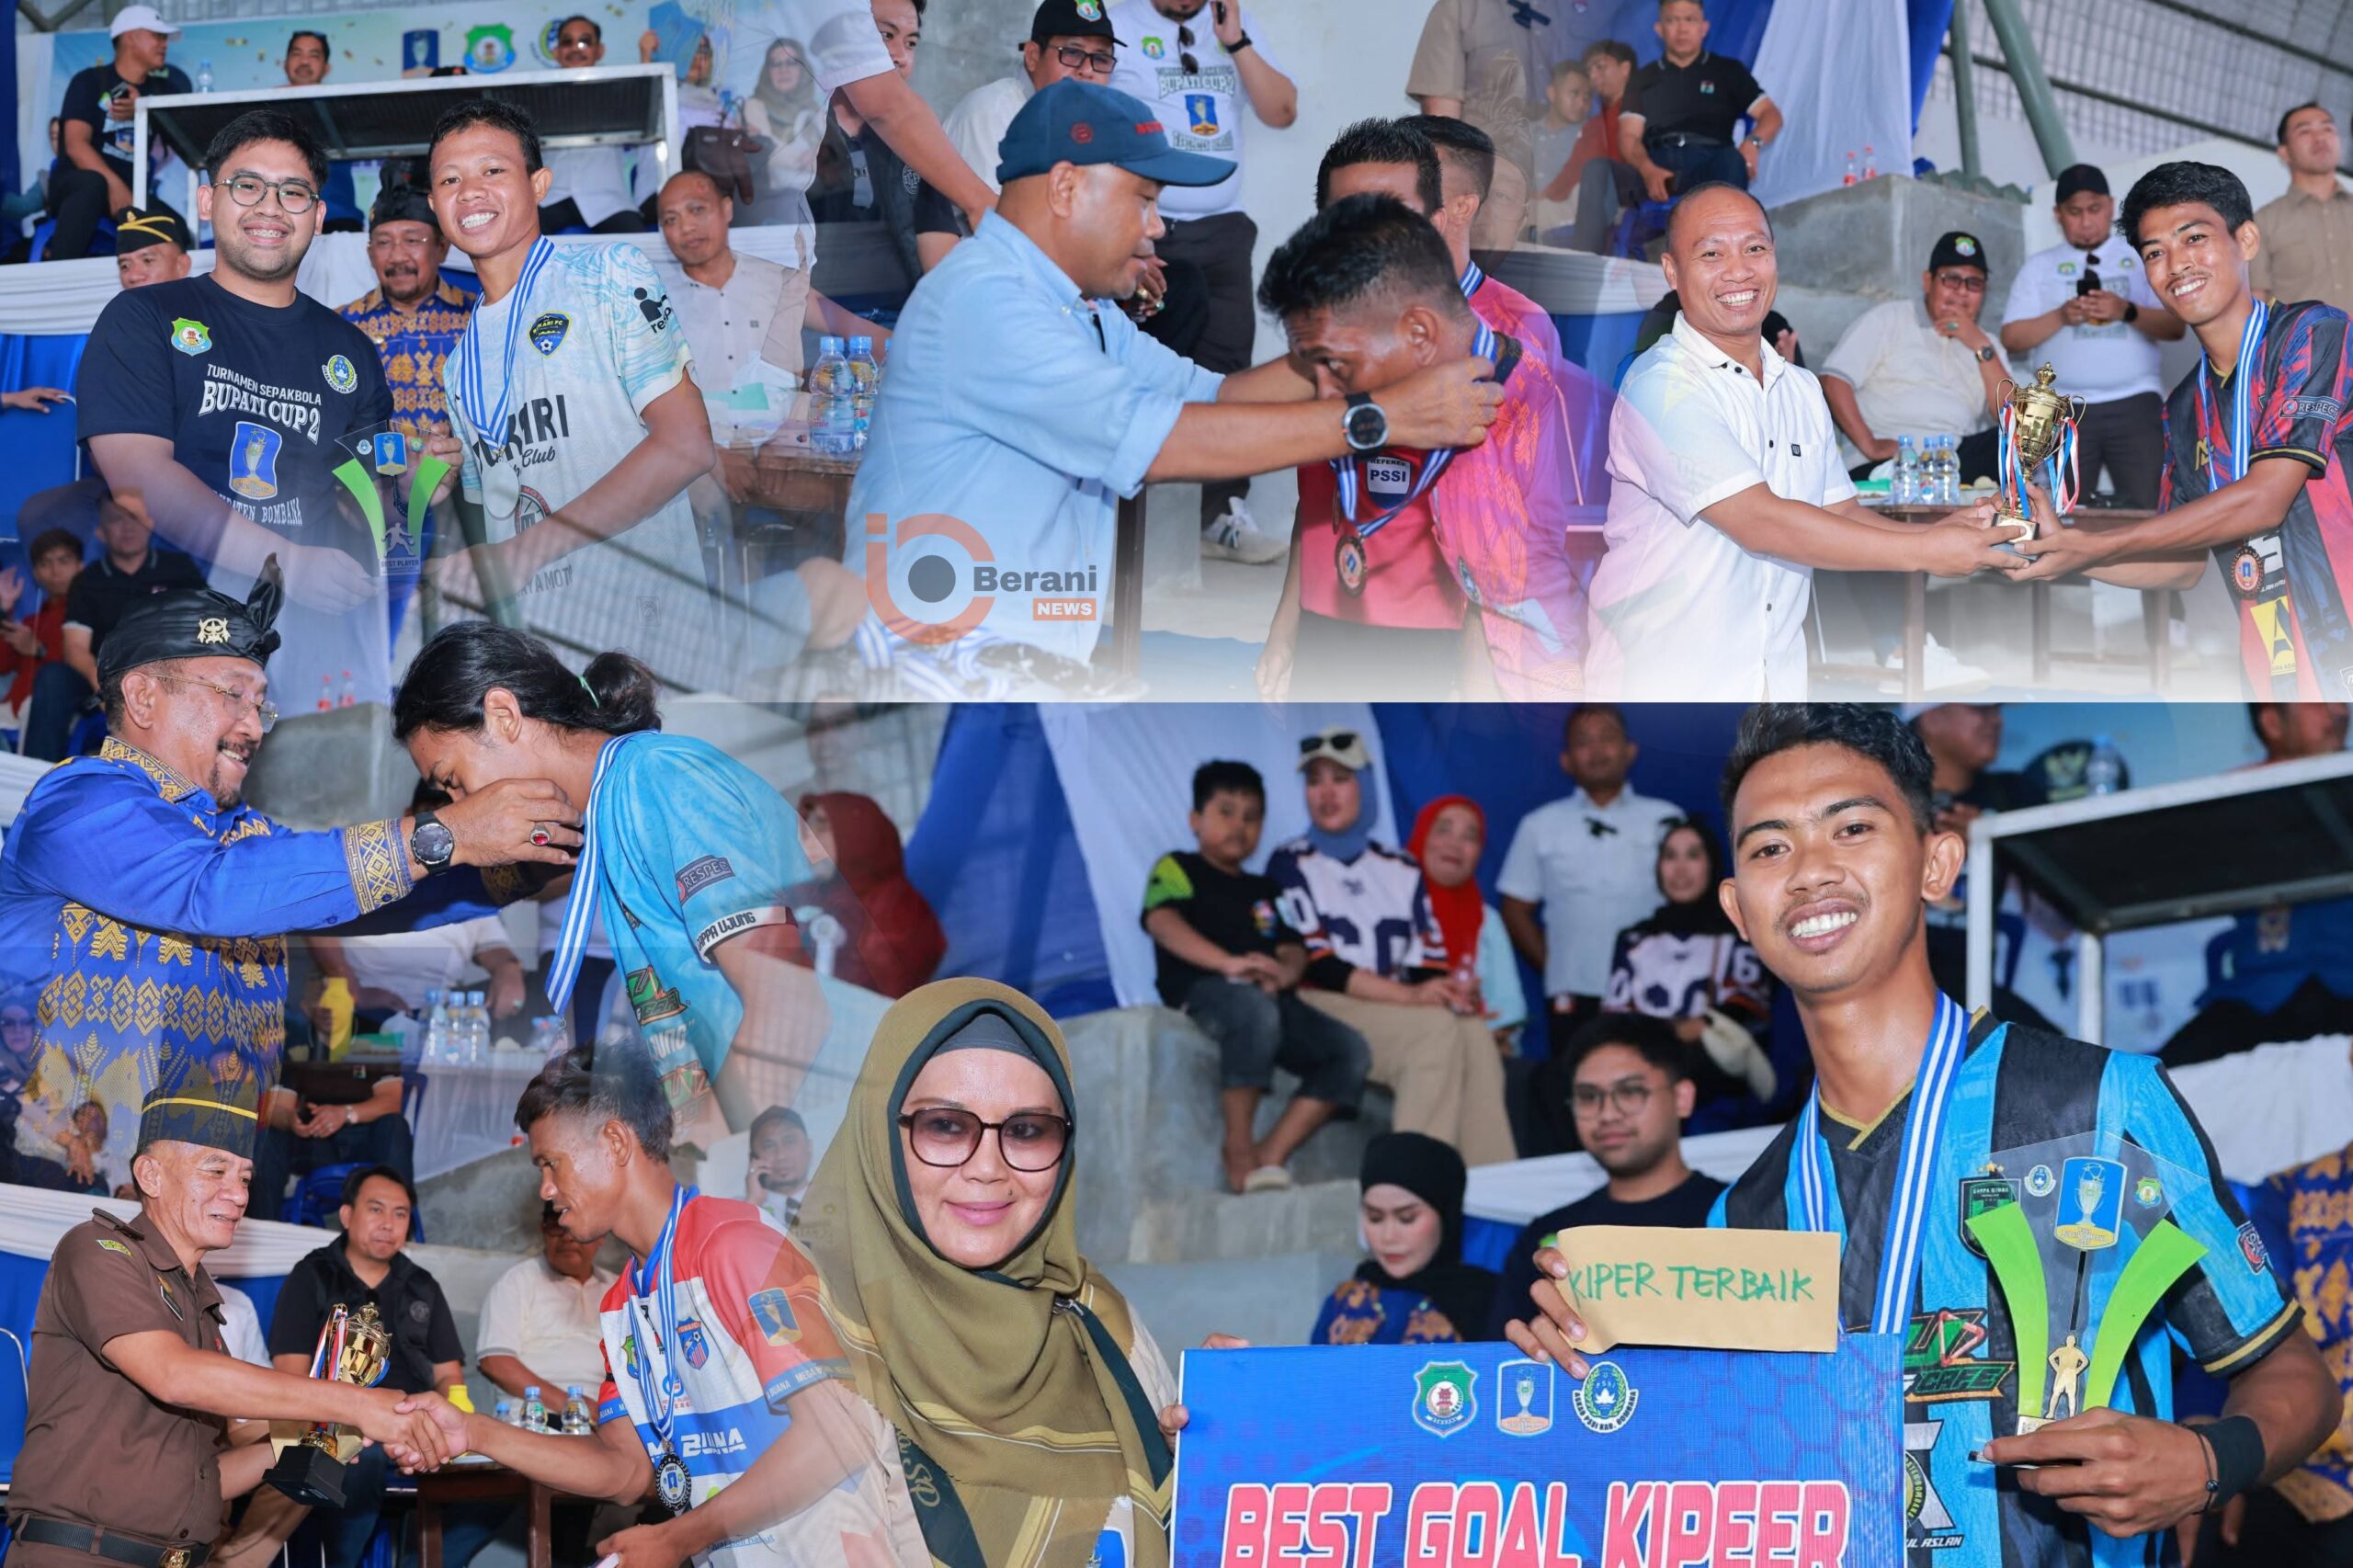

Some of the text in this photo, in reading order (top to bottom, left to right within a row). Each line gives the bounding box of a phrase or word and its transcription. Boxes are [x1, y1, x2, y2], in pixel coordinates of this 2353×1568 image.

[207, 363, 259, 392] TURNAMEN
[259, 383, 322, 406] SEPAKBOLA
[198, 380, 321, 446] BUPATI CUP 2
[521, 445, 556, 468] Club
[1370, 470, 1406, 483] PSSI
[261, 497, 302, 527] BOMBANA
[397, 559, 420, 567] PLAYER
[720, 911, 756, 933] UJUNG
[1568, 1262, 1814, 1309] KIPER TERBAIK
[1222, 1479, 1853, 1568] BEST GOAL KIPEER
[1920, 1536, 1962, 1548] ASLAN
